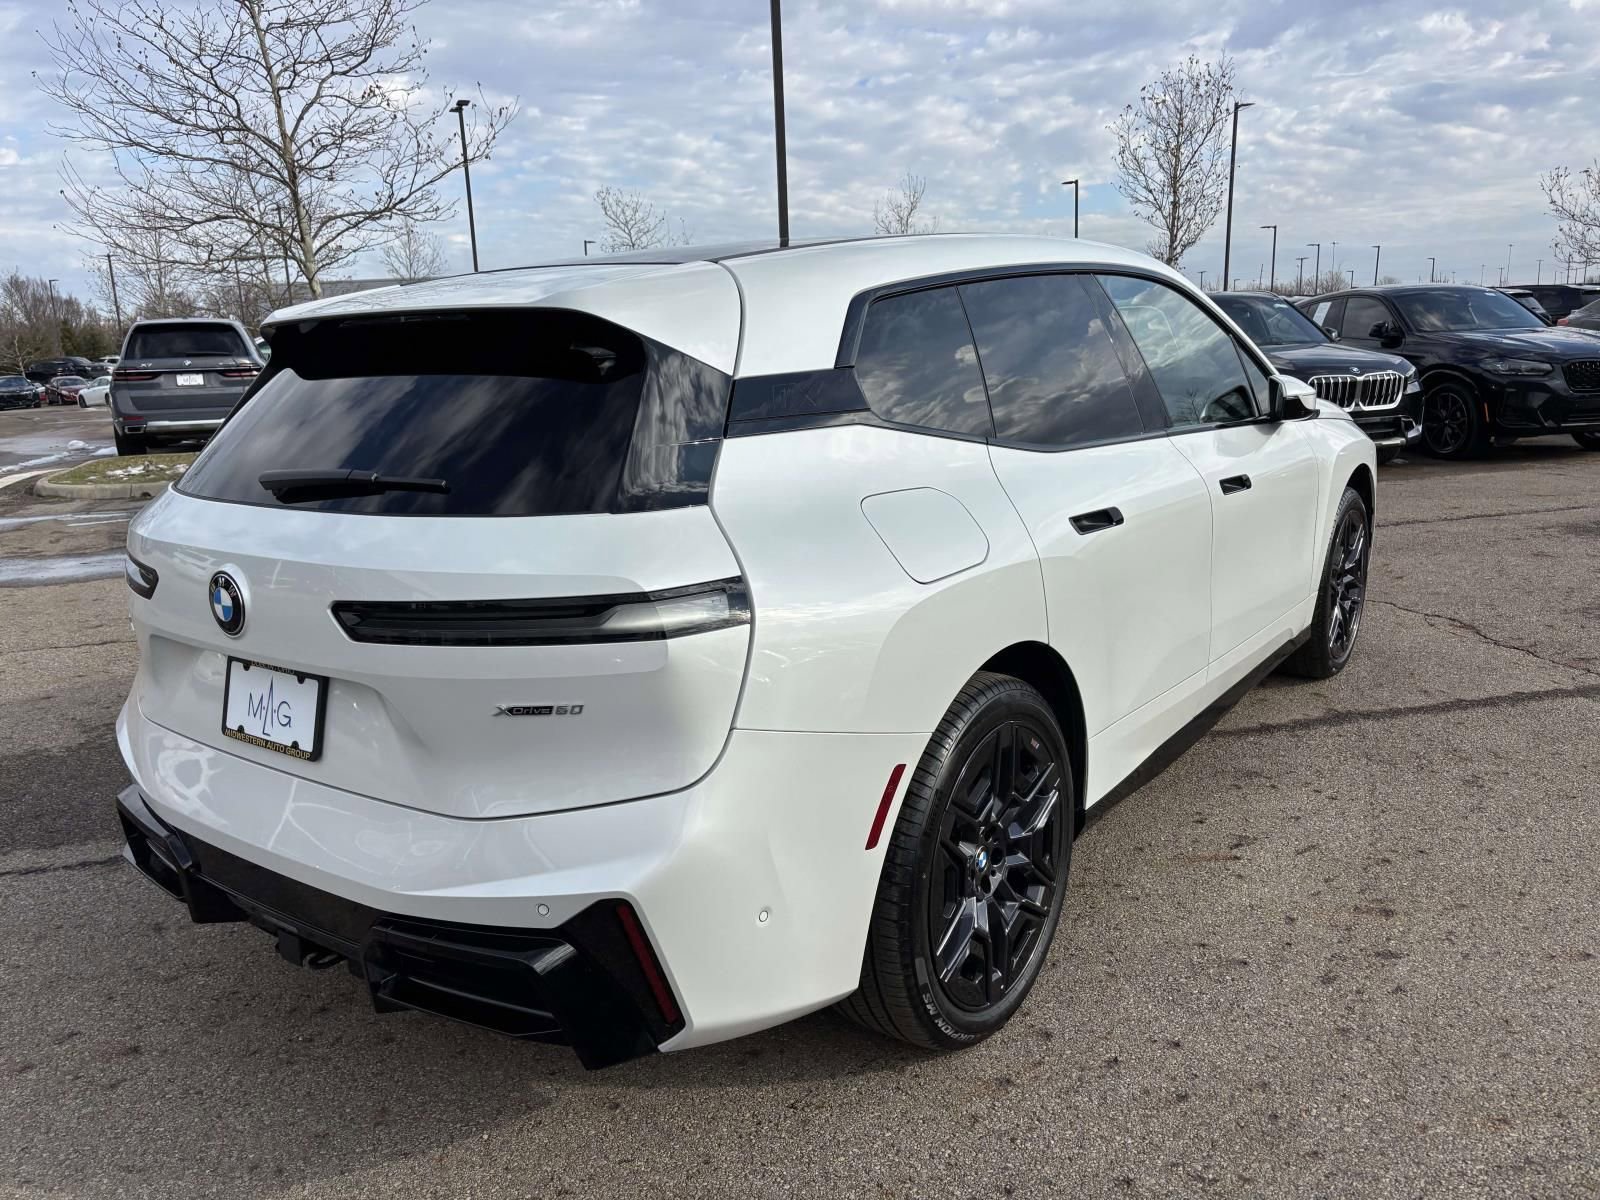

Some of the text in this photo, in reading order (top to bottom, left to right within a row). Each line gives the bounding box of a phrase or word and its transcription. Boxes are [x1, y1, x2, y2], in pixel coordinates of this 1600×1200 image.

[210, 576, 237, 597] BMW
[555, 704, 585, 716] 60
[224, 729, 311, 760] MIDWESTERN AUTO GROUP
